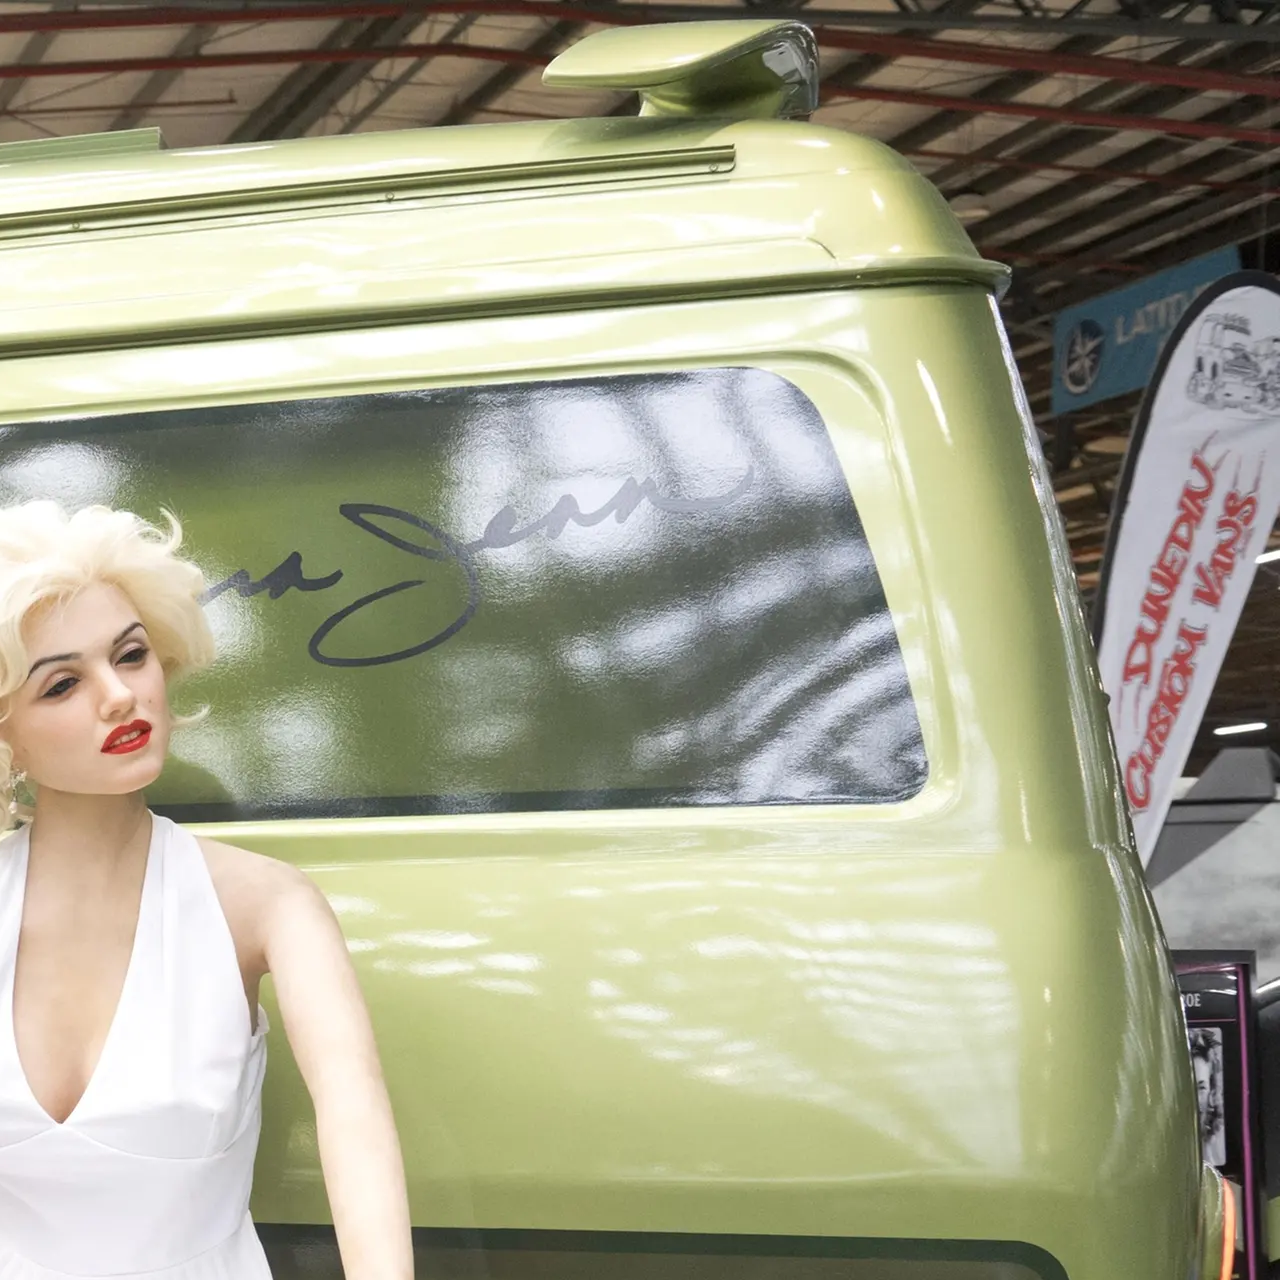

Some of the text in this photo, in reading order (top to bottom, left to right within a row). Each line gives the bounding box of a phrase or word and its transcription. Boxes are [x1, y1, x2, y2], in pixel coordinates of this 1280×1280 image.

[1123, 451, 1217, 686] DUNEDIN
[1125, 490, 1259, 813] CUSTOM VANS
